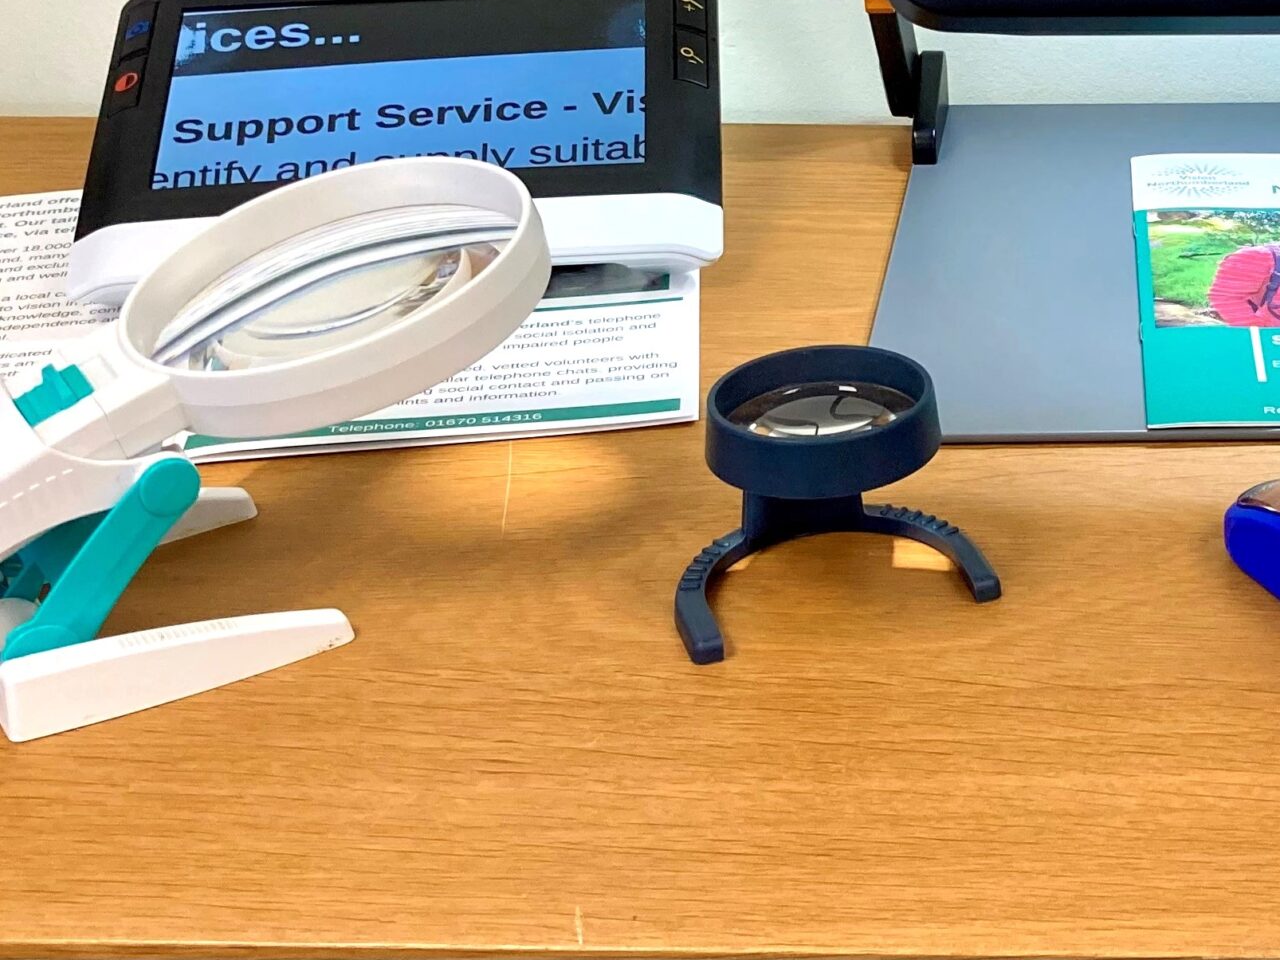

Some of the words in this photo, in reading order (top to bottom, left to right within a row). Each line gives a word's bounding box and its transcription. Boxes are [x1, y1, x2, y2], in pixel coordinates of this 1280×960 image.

[173, 108, 361, 146] Support
[375, 97, 549, 129] Service
[15, 219, 47, 227] Our
[29, 253, 70, 261] many
[7, 273, 35, 282] and
[16, 291, 51, 301] local
[18, 301, 61, 311] vision
[588, 312, 662, 325] telephone
[514, 330, 558, 340] social
[562, 325, 625, 337] isolation
[629, 321, 657, 331] and
[503, 339, 568, 351] impaired
[573, 334, 625, 347] people
[492, 360, 540, 370] vetted
[544, 354, 625, 367] volunteers
[629, 351, 660, 361] with
[475, 368, 552, 383] telephone
[608, 359, 679, 374] providing
[439, 383, 484, 394] social
[488, 379, 547, 391] contact
[551, 376, 581, 387] and
[585, 371, 646, 386] passing
[650, 370, 671, 379] on
[434, 394, 464, 405] and
[469, 388, 562, 402] information.
[328, 420, 420, 434] Telephone:
[425, 416, 477, 428] 01670
[482, 412, 543, 425] 514316
